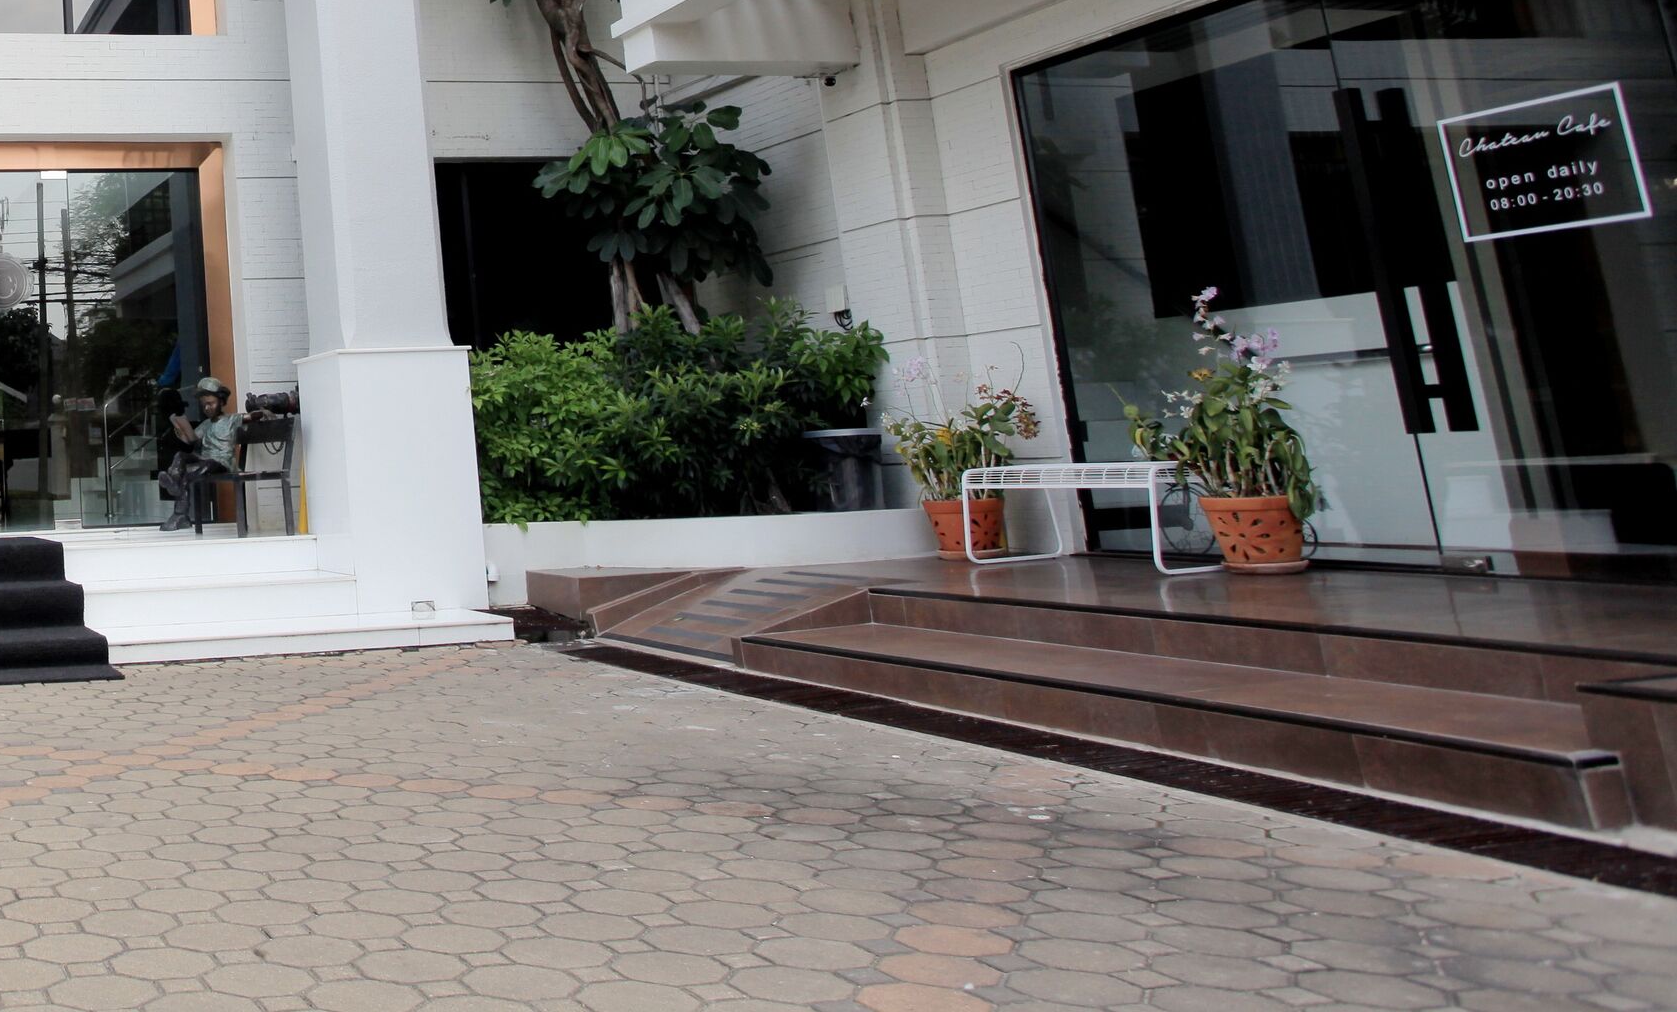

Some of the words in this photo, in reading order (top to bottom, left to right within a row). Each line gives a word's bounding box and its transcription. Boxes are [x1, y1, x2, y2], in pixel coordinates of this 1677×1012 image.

[1459, 131, 1550, 158] Chateau
[1556, 113, 1612, 136] Cafe
[1485, 171, 1535, 190] open
[1546, 159, 1598, 180] daily
[1489, 192, 1537, 211] 08:00
[1552, 182, 1604, 202] 20:30
